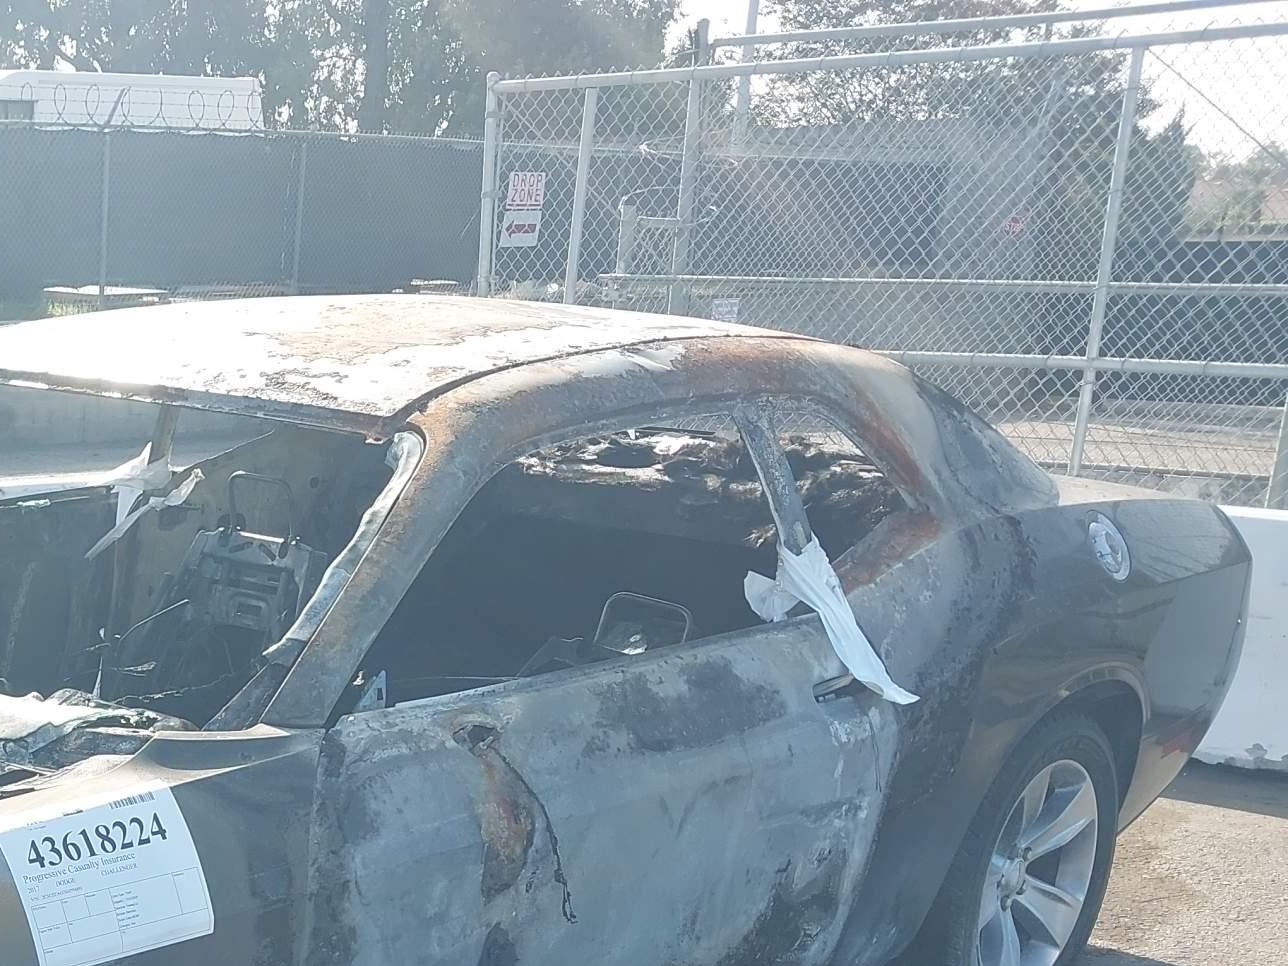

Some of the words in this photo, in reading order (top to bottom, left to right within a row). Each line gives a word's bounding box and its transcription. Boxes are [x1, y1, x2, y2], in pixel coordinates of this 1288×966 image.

[513, 173, 543, 188] DROP
[511, 188, 542, 202] ZONE
[27, 811, 168, 869] 43618224
[22, 867, 67, 885] Progressive
[67, 859, 99, 874] Casualty
[100, 853, 136, 866] Insurance
